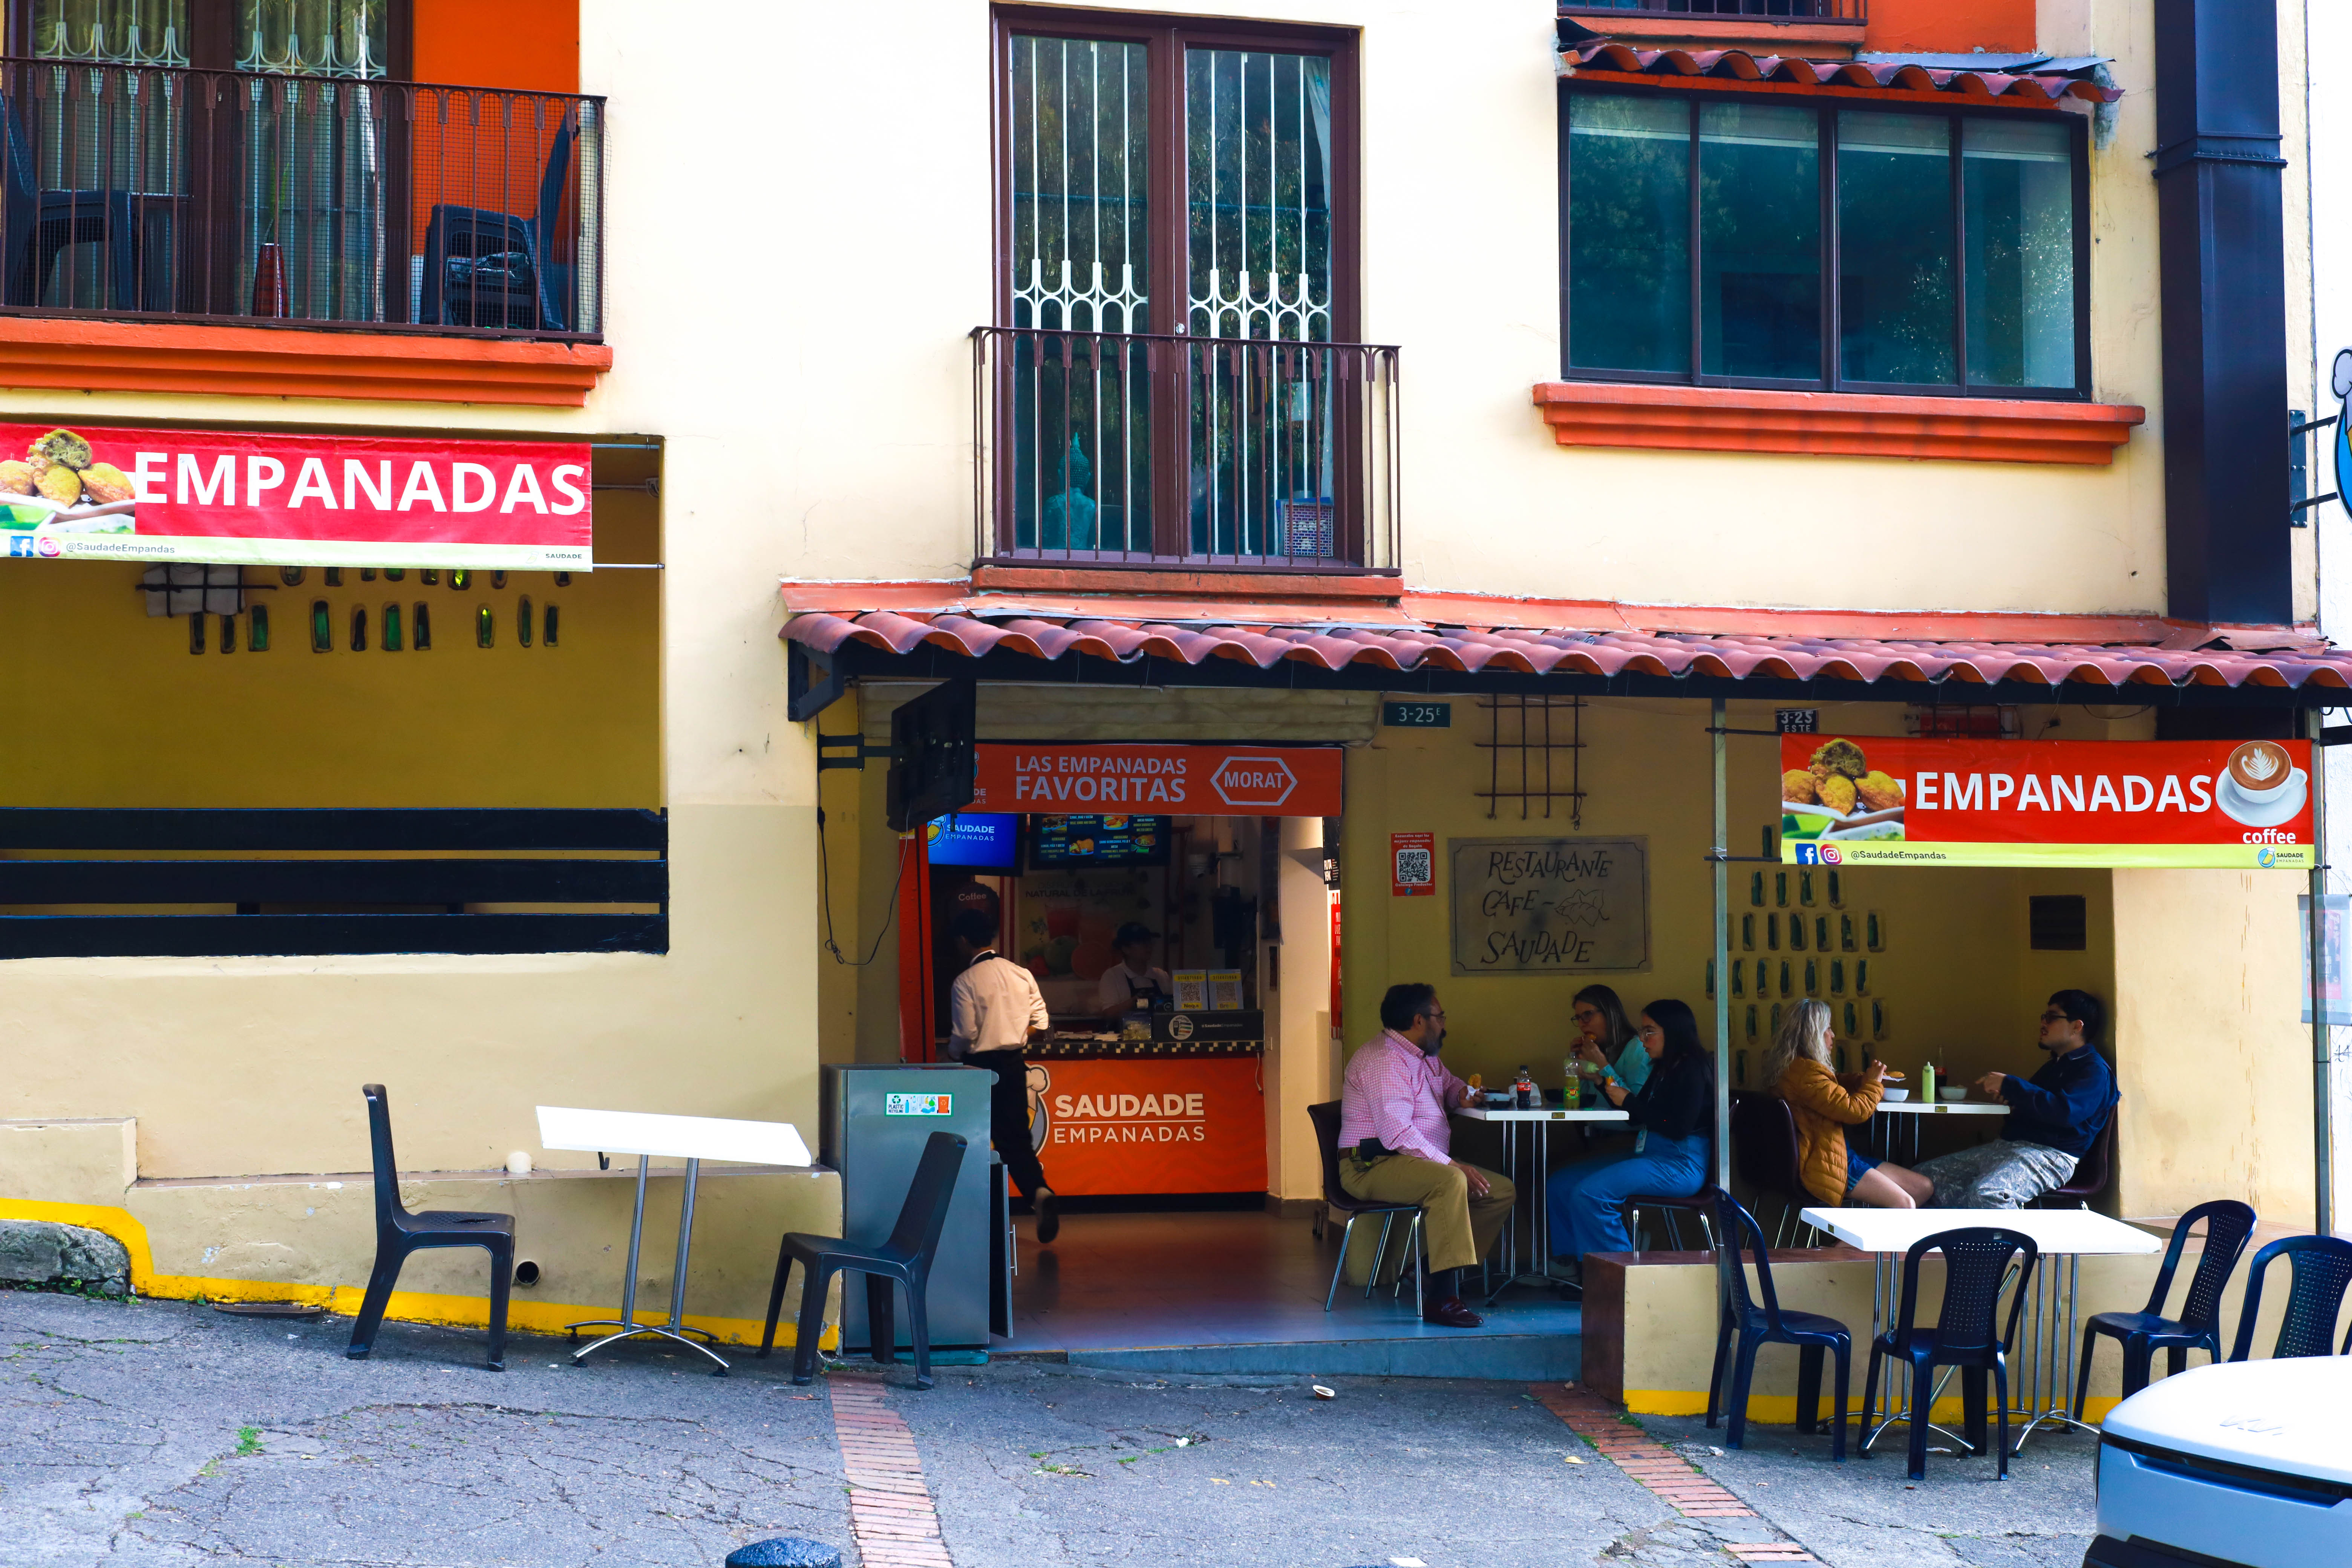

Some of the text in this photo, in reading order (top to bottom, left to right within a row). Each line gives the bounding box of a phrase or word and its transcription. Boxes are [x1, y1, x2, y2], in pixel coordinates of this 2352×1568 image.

[135, 451, 585, 515] EMPANADAS
[66, 543, 175, 554] @SaudadeEmpandas
[1781, 710, 1813, 724] 3-25
[1016, 756, 1187, 775] LAS EMPANADAS
[1224, 771, 1285, 788] MORAT
[1016, 776, 1186, 802] FAVORITAS
[1916, 772, 2212, 813] EMPANADAS
[946, 824, 995, 833] SAUDADE
[2243, 828, 2296, 844] coffee
[1851, 851, 1946, 860] @SaudadeEmpandas
[1488, 851, 1613, 885] RESTAURANTE
[959, 893, 986, 901] Coffee
[1483, 890, 1539, 917] CAFE
[1481, 931, 1594, 963] SAUDADE
[1055, 1093, 1204, 1118] SAUDADE
[1054, 1126, 1205, 1143] EMPANADAS
